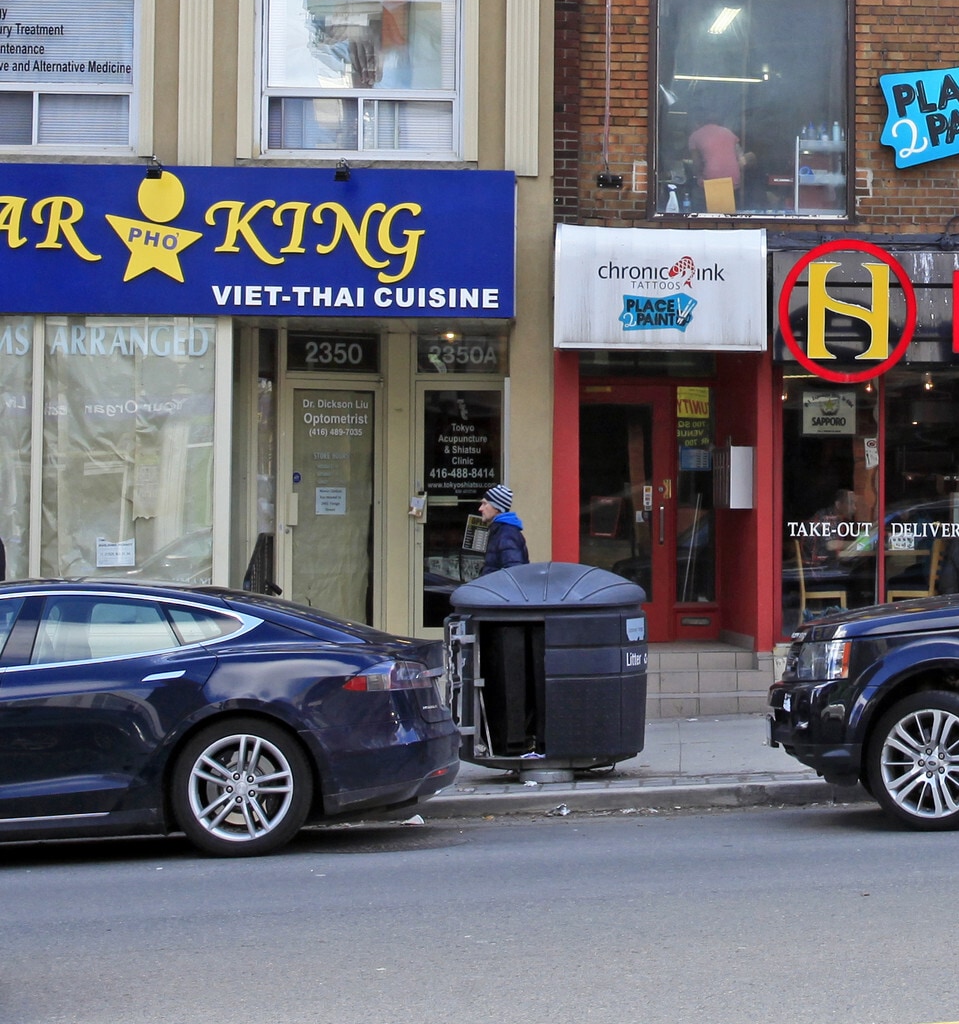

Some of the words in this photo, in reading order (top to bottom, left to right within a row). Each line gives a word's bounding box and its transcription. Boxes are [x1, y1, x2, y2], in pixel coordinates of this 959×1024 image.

[16, 23, 64, 35] Treatment
[12, 60, 30, 72] and
[33, 60, 85, 73] Alternative
[88, 61, 131, 74] Medicine
[891, 118, 928, 158] 2
[204, 199, 425, 283] KING
[598, 261, 668, 280] chronic
[697, 263, 725, 282] ink
[631, 280, 680, 290] TATTOOS
[212, 285, 364, 307] VIET-THAI
[374, 287, 499, 308] CUISINE
[626, 298, 675, 313] PLACE
[623, 313, 636, 328] 2
[637, 312, 675, 326] PAINT
[50, 325, 209, 357] ARRANGED
[305, 341, 363, 365] 2350
[429, 345, 497, 364] 2350A
[303, 399, 315, 408] Dr.
[318, 399, 353, 409] Dickson
[355, 400, 368, 409] Liu
[304, 413, 368, 426] Optometrist
[812, 417, 846, 426] SAPPORO
[309, 428, 327, 437] (416)
[330, 428, 363, 436] 489-7035
[451, 423, 475, 433] Tokyo
[438, 435, 488, 444] Acupuncture
[444, 446, 450, 454] &
[452, 445, 481, 454] Shiatsu
[452, 457, 474, 465] Clinic
[429, 468, 495, 478] 416-488-8414
[787, 521, 873, 538] TAKE-OUT
[626, 652, 641, 666] Litter
